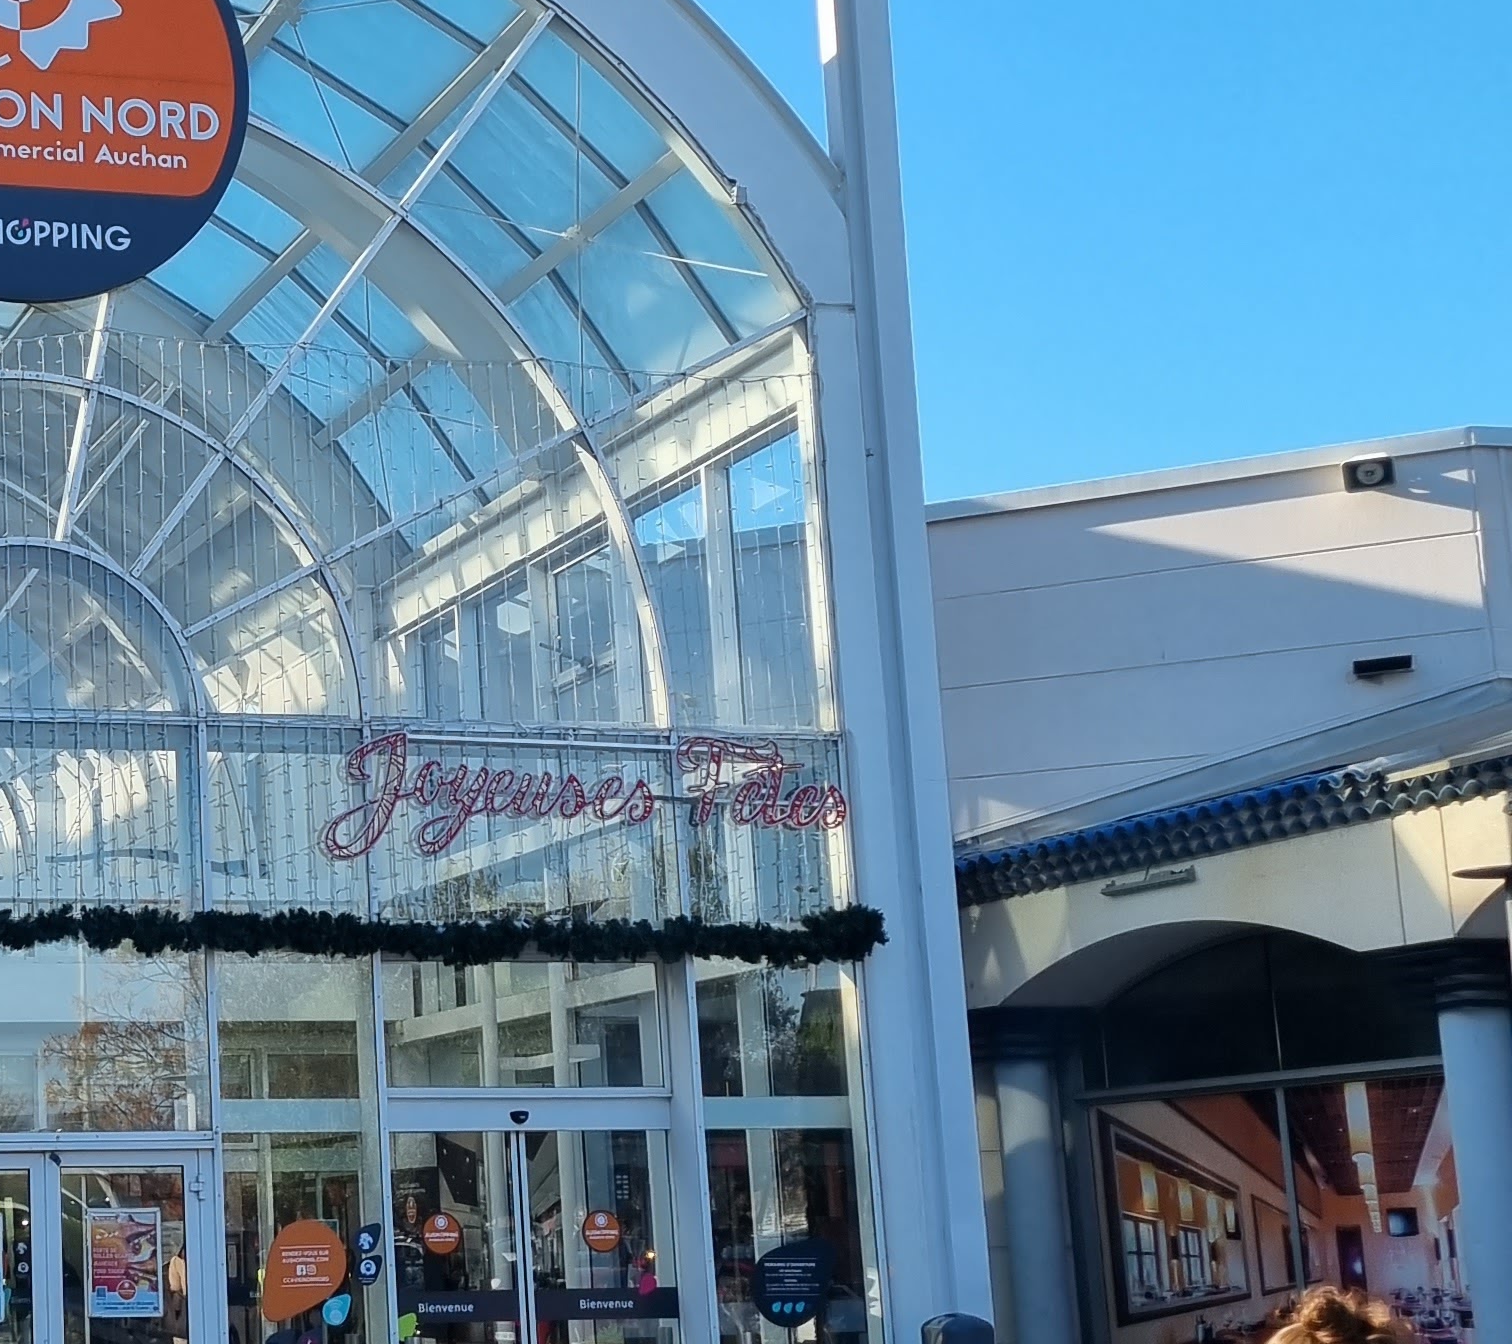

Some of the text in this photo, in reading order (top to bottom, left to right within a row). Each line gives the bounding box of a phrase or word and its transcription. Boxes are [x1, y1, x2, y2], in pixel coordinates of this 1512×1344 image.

[81, 95, 221, 141] NORD
[94, 144, 188, 169] Auchan
[325, 731, 655, 860] Joyeuses
[418, 1302, 475, 1314] Bienvenue
[579, 1298, 635, 1310] Bienvenue
